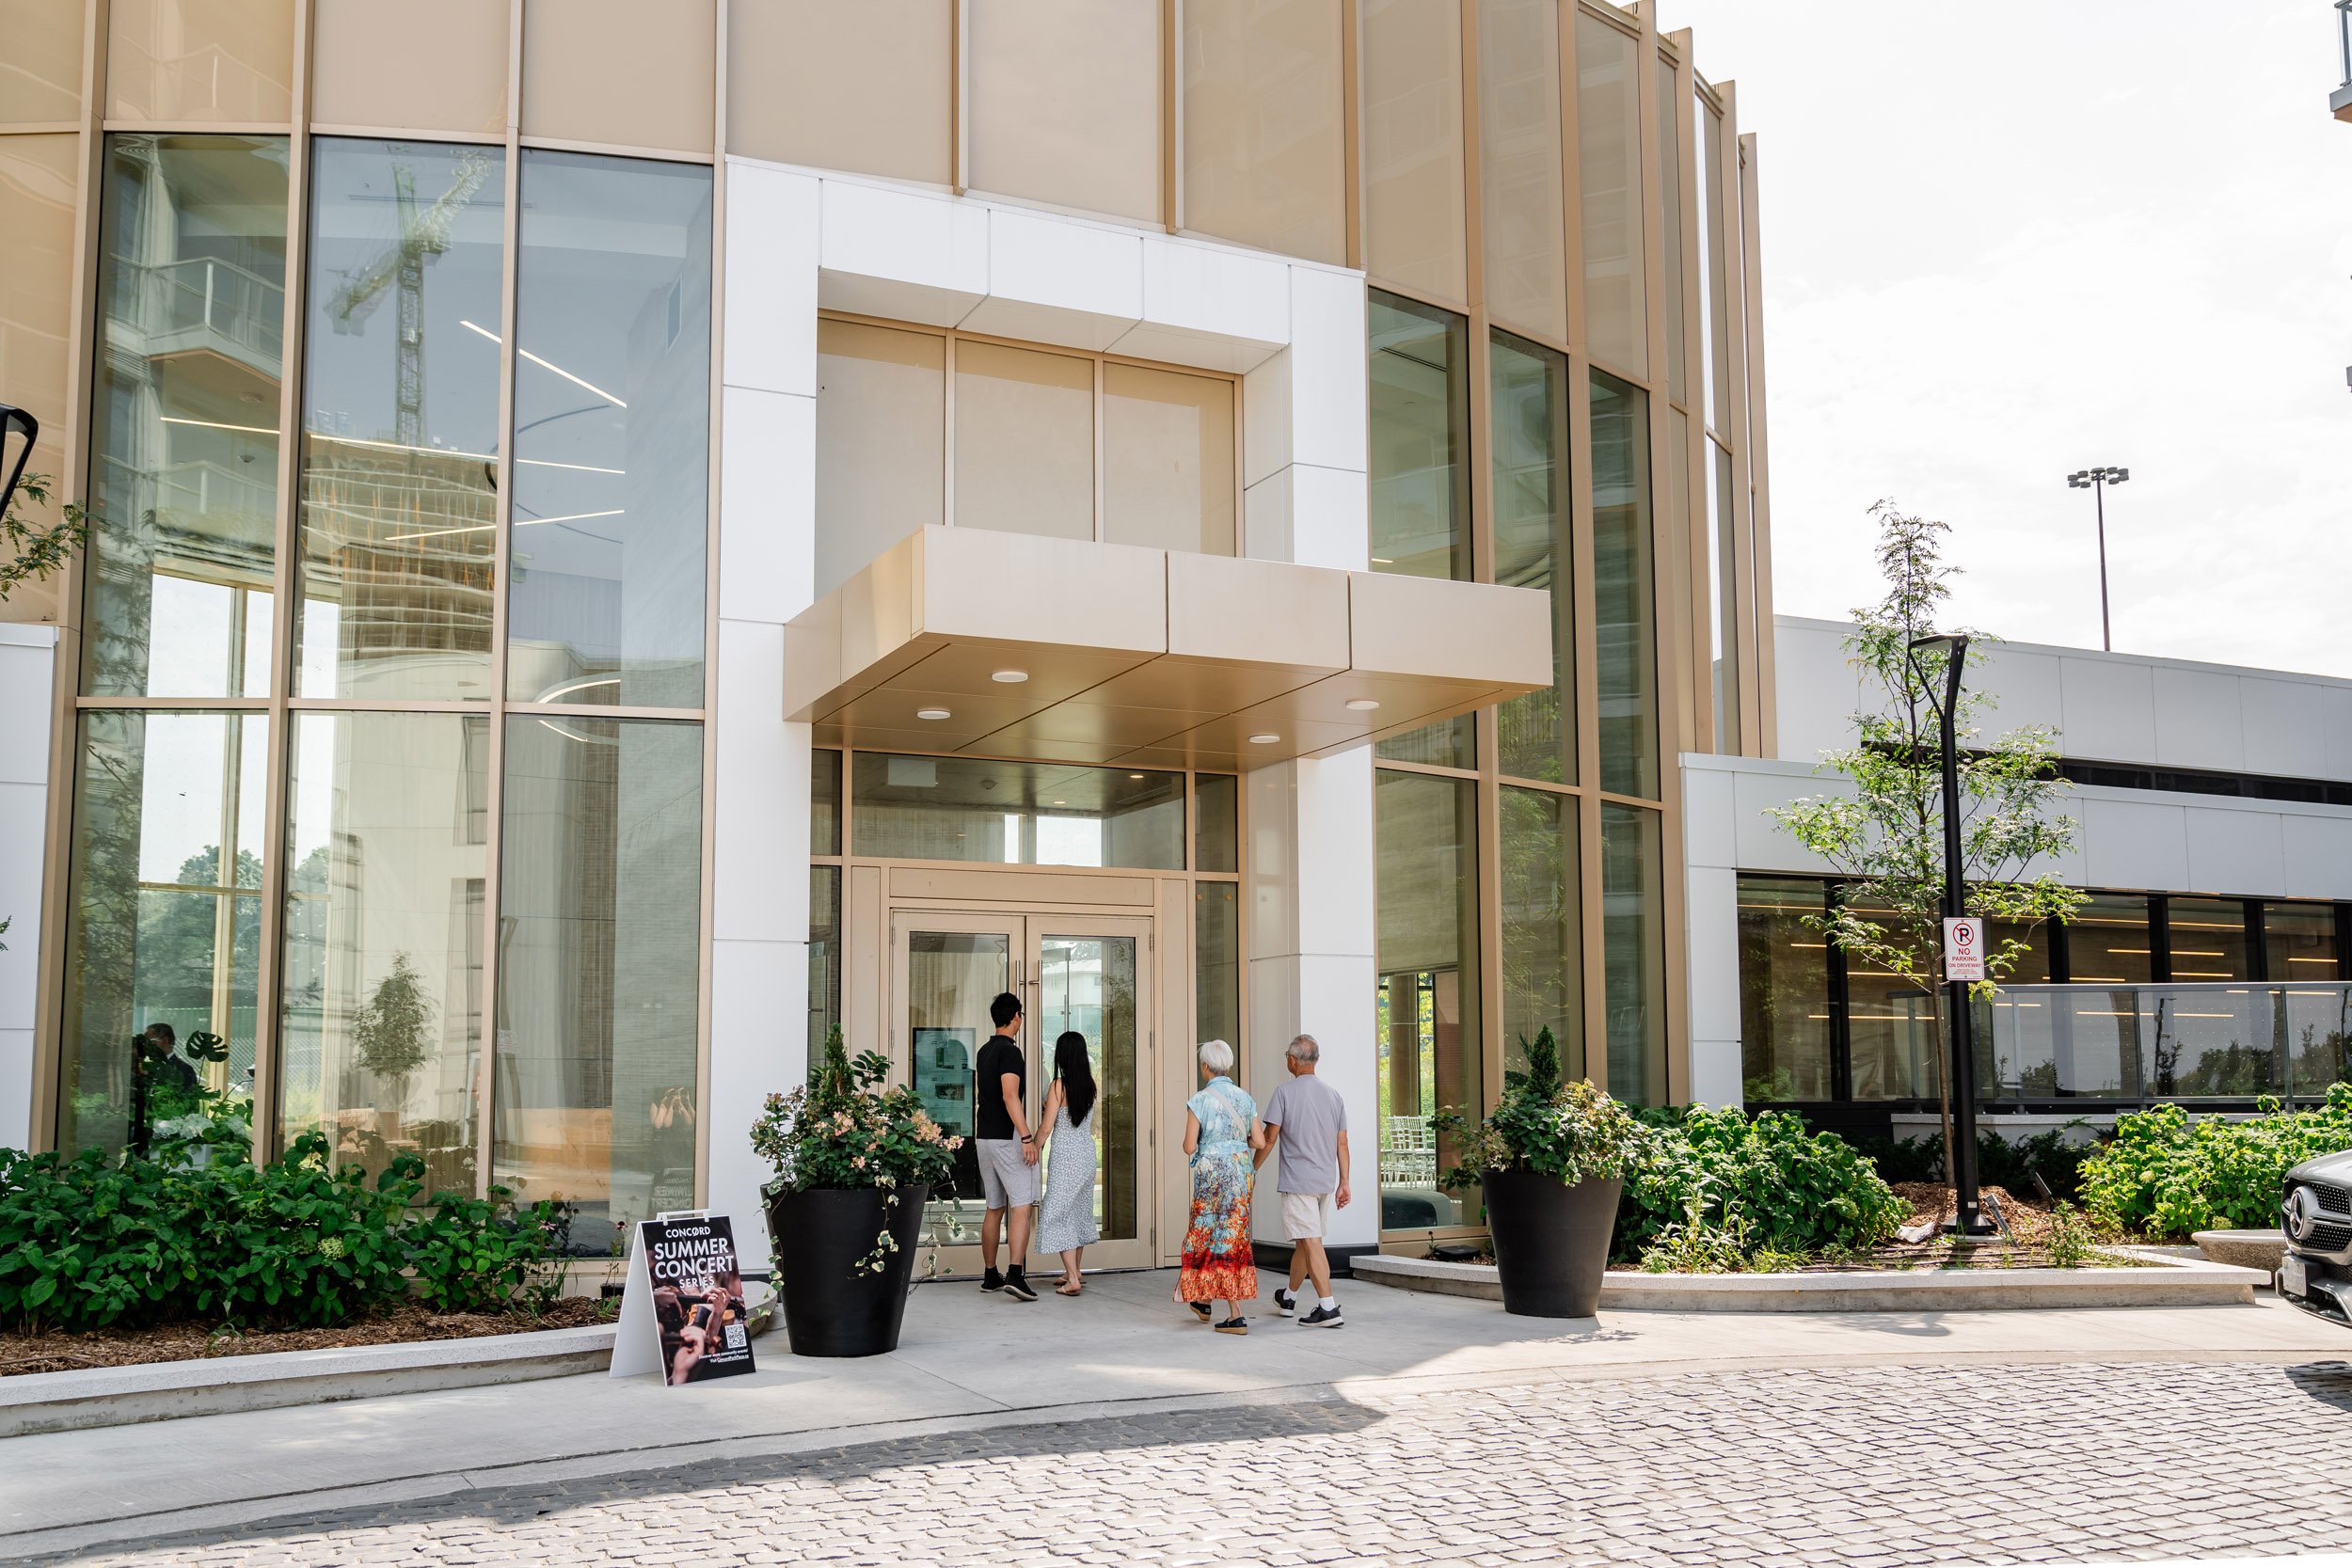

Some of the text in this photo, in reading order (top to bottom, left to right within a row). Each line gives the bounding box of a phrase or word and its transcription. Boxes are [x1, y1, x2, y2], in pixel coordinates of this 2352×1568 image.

[654, 1237, 729, 1260] SUMMER
[655, 1255, 734, 1279] CONCERT
[679, 1275, 715, 1289] SERIES
